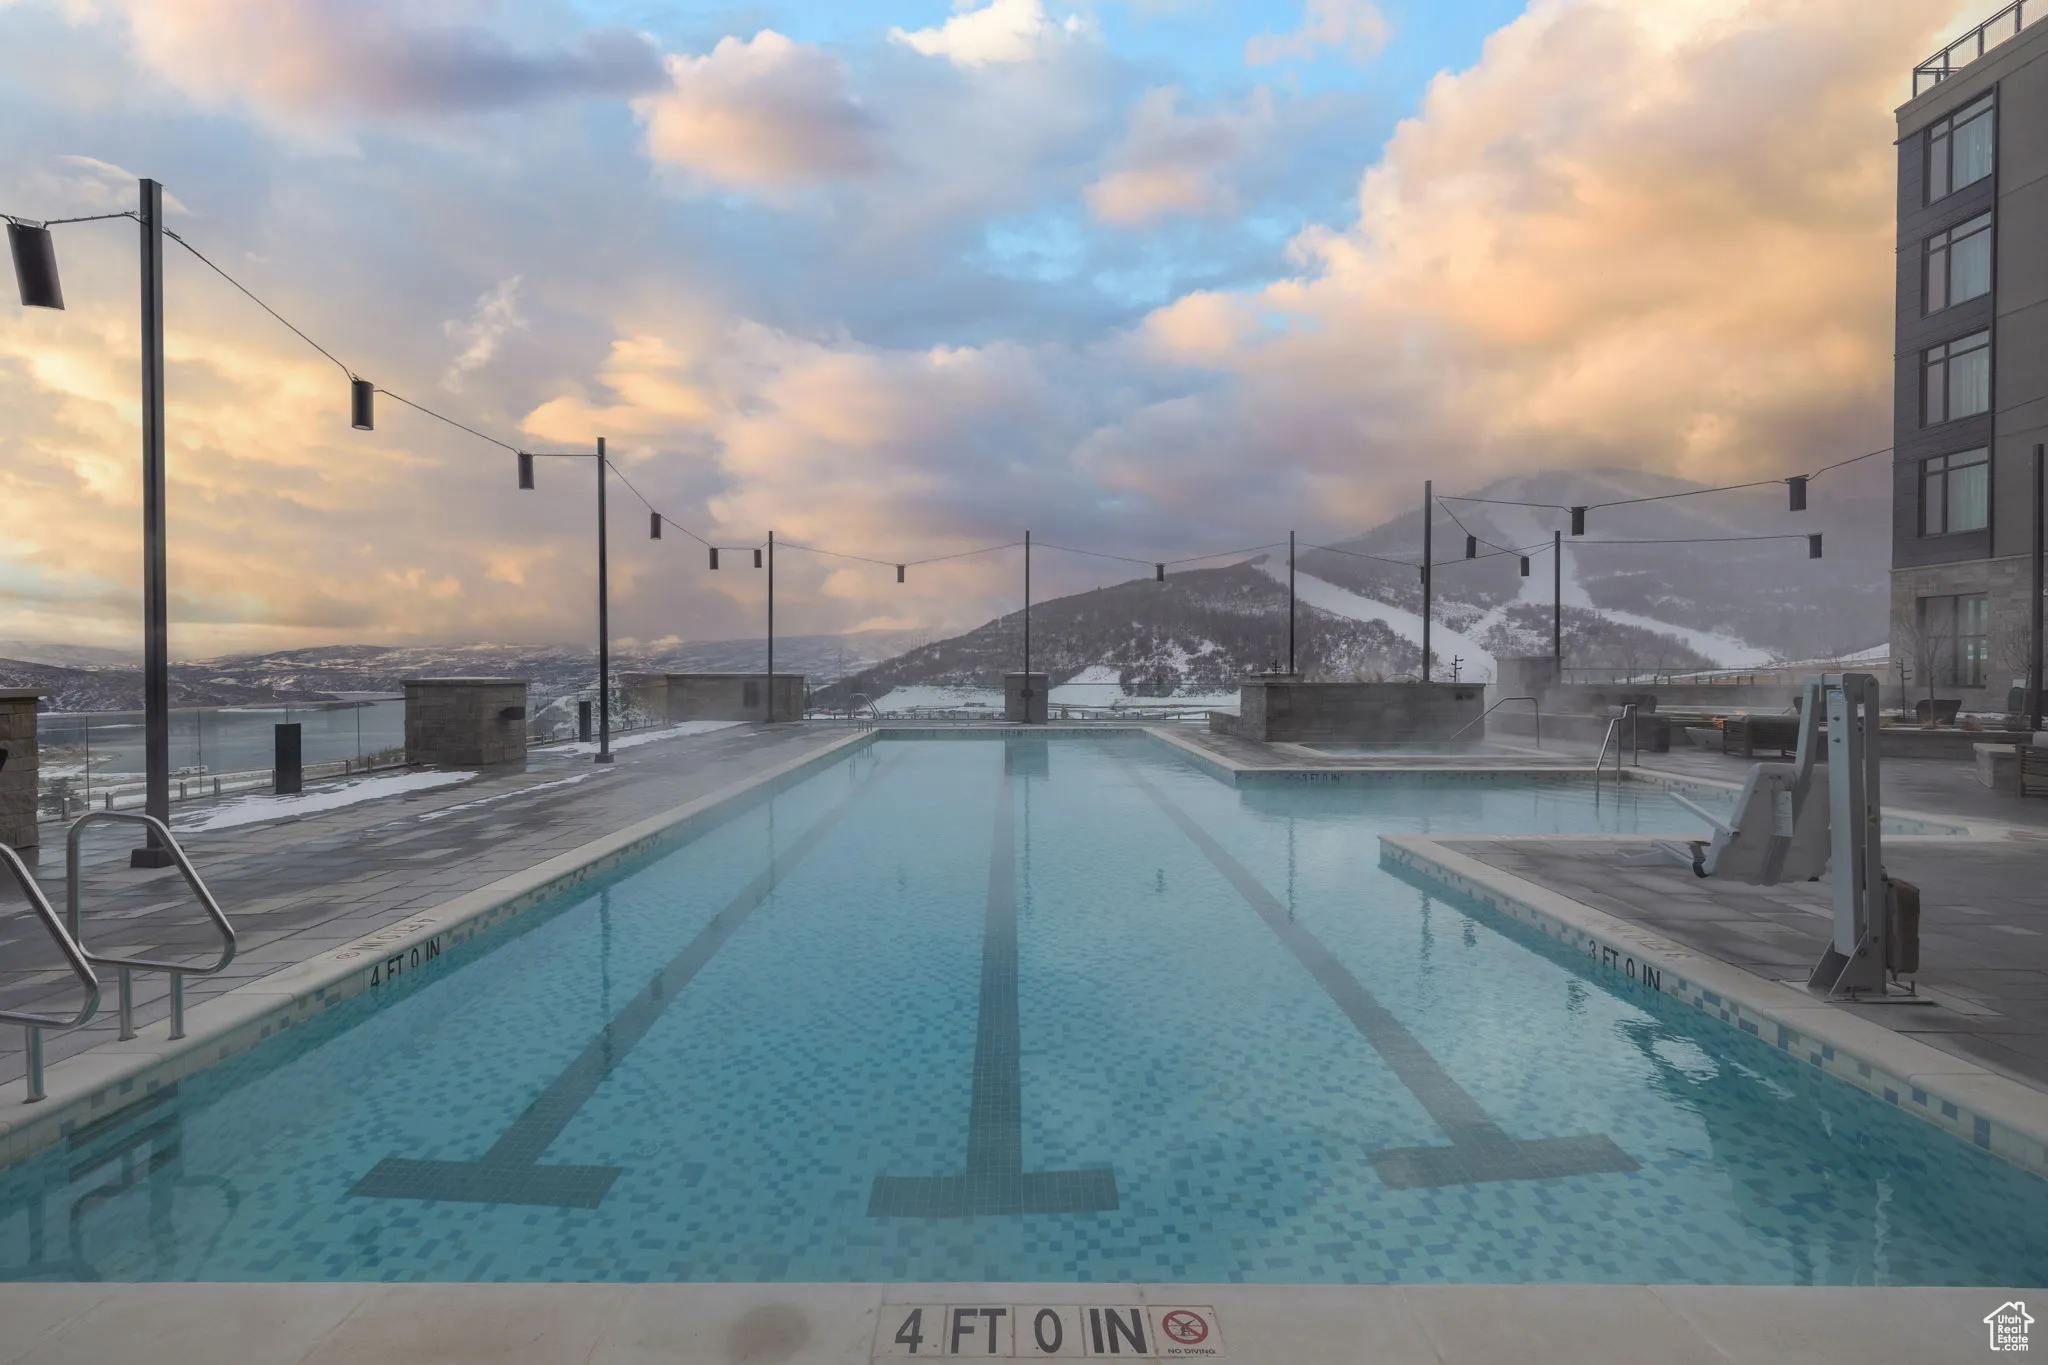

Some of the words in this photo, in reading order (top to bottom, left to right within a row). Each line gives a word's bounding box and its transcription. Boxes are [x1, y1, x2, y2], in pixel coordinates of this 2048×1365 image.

[370, 965, 380, 988] 4
[387, 954, 404, 981] FT
[410, 947, 420, 969] 0
[426, 936, 440, 962] IN
[1588, 939, 1597, 961] 3
[1602, 945, 1619, 970] FT
[1625, 957, 1635, 979] 0
[1643, 964, 1661, 992] IN
[894, 1308, 924, 1354] 4
[950, 1308, 1007, 1354] FT
[1033, 1308, 1063, 1354] 0
[1089, 1308, 1148, 1354] IN
